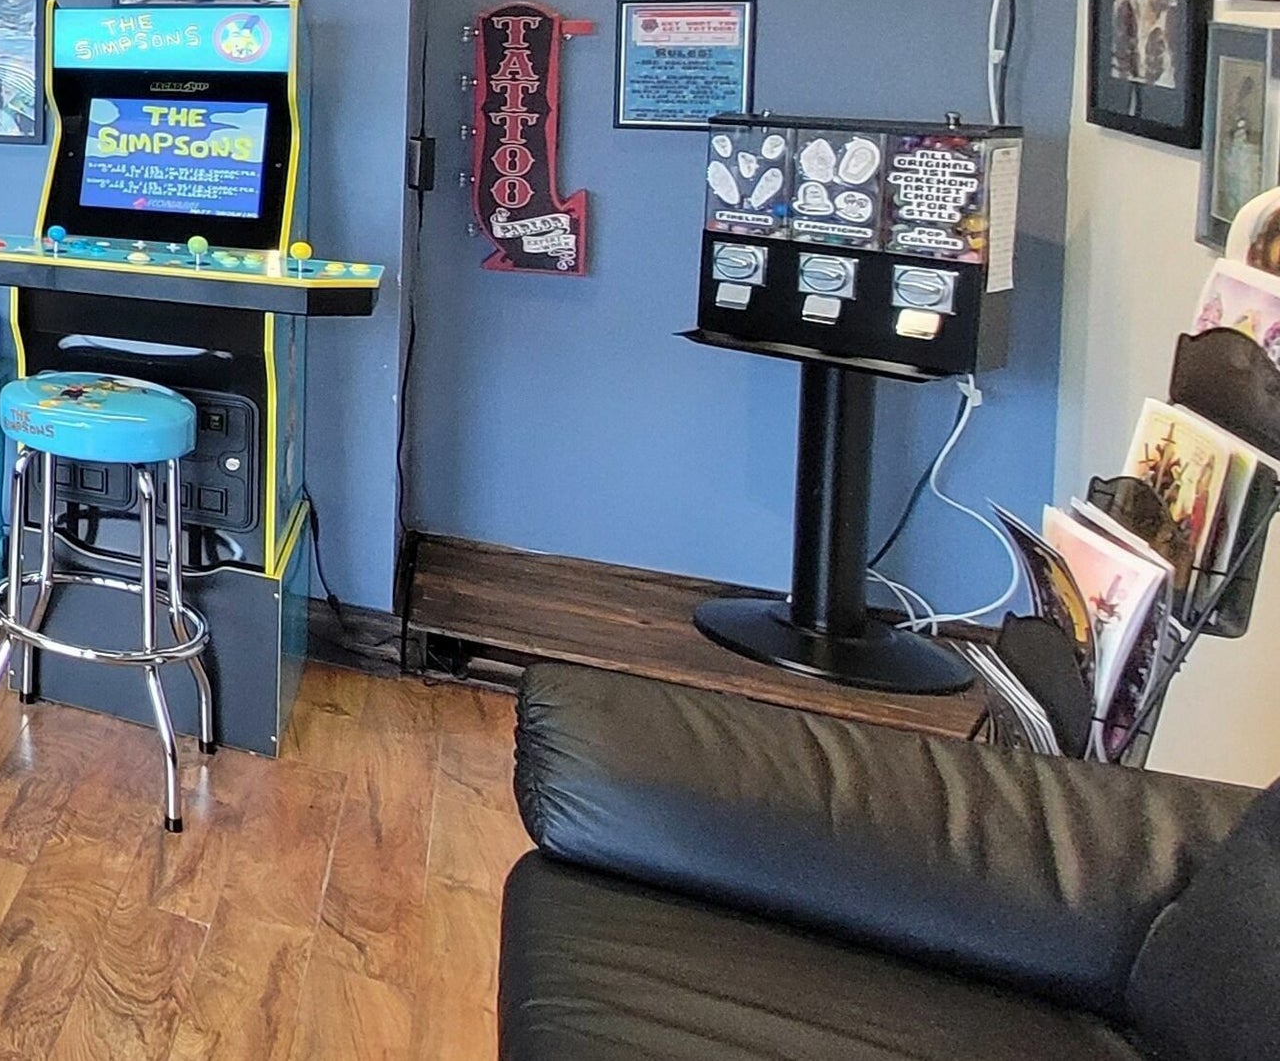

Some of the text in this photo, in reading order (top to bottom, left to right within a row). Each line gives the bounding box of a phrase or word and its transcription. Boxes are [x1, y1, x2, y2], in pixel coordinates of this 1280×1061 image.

[101, 14, 153, 36] THE
[74, 25, 202, 60] SIMPSONS
[142, 105, 208, 128] THE
[489, 16, 543, 209] TATTOO
[97, 126, 254, 161] SIMPSONS
[919, 151, 951, 161] ALL
[897, 158, 973, 172] ORIGINAL
[892, 174, 976, 189] POKEMON!
[903, 184, 963, 196] ARTIST
[903, 192, 962, 204] CHOICE
[916, 202, 948, 211] FOR
[905, 208, 957, 221] STYLE
[917, 229, 944, 237] POP
[900, 234, 959, 248] CULTURE
[10, 408, 31, 422] THE
